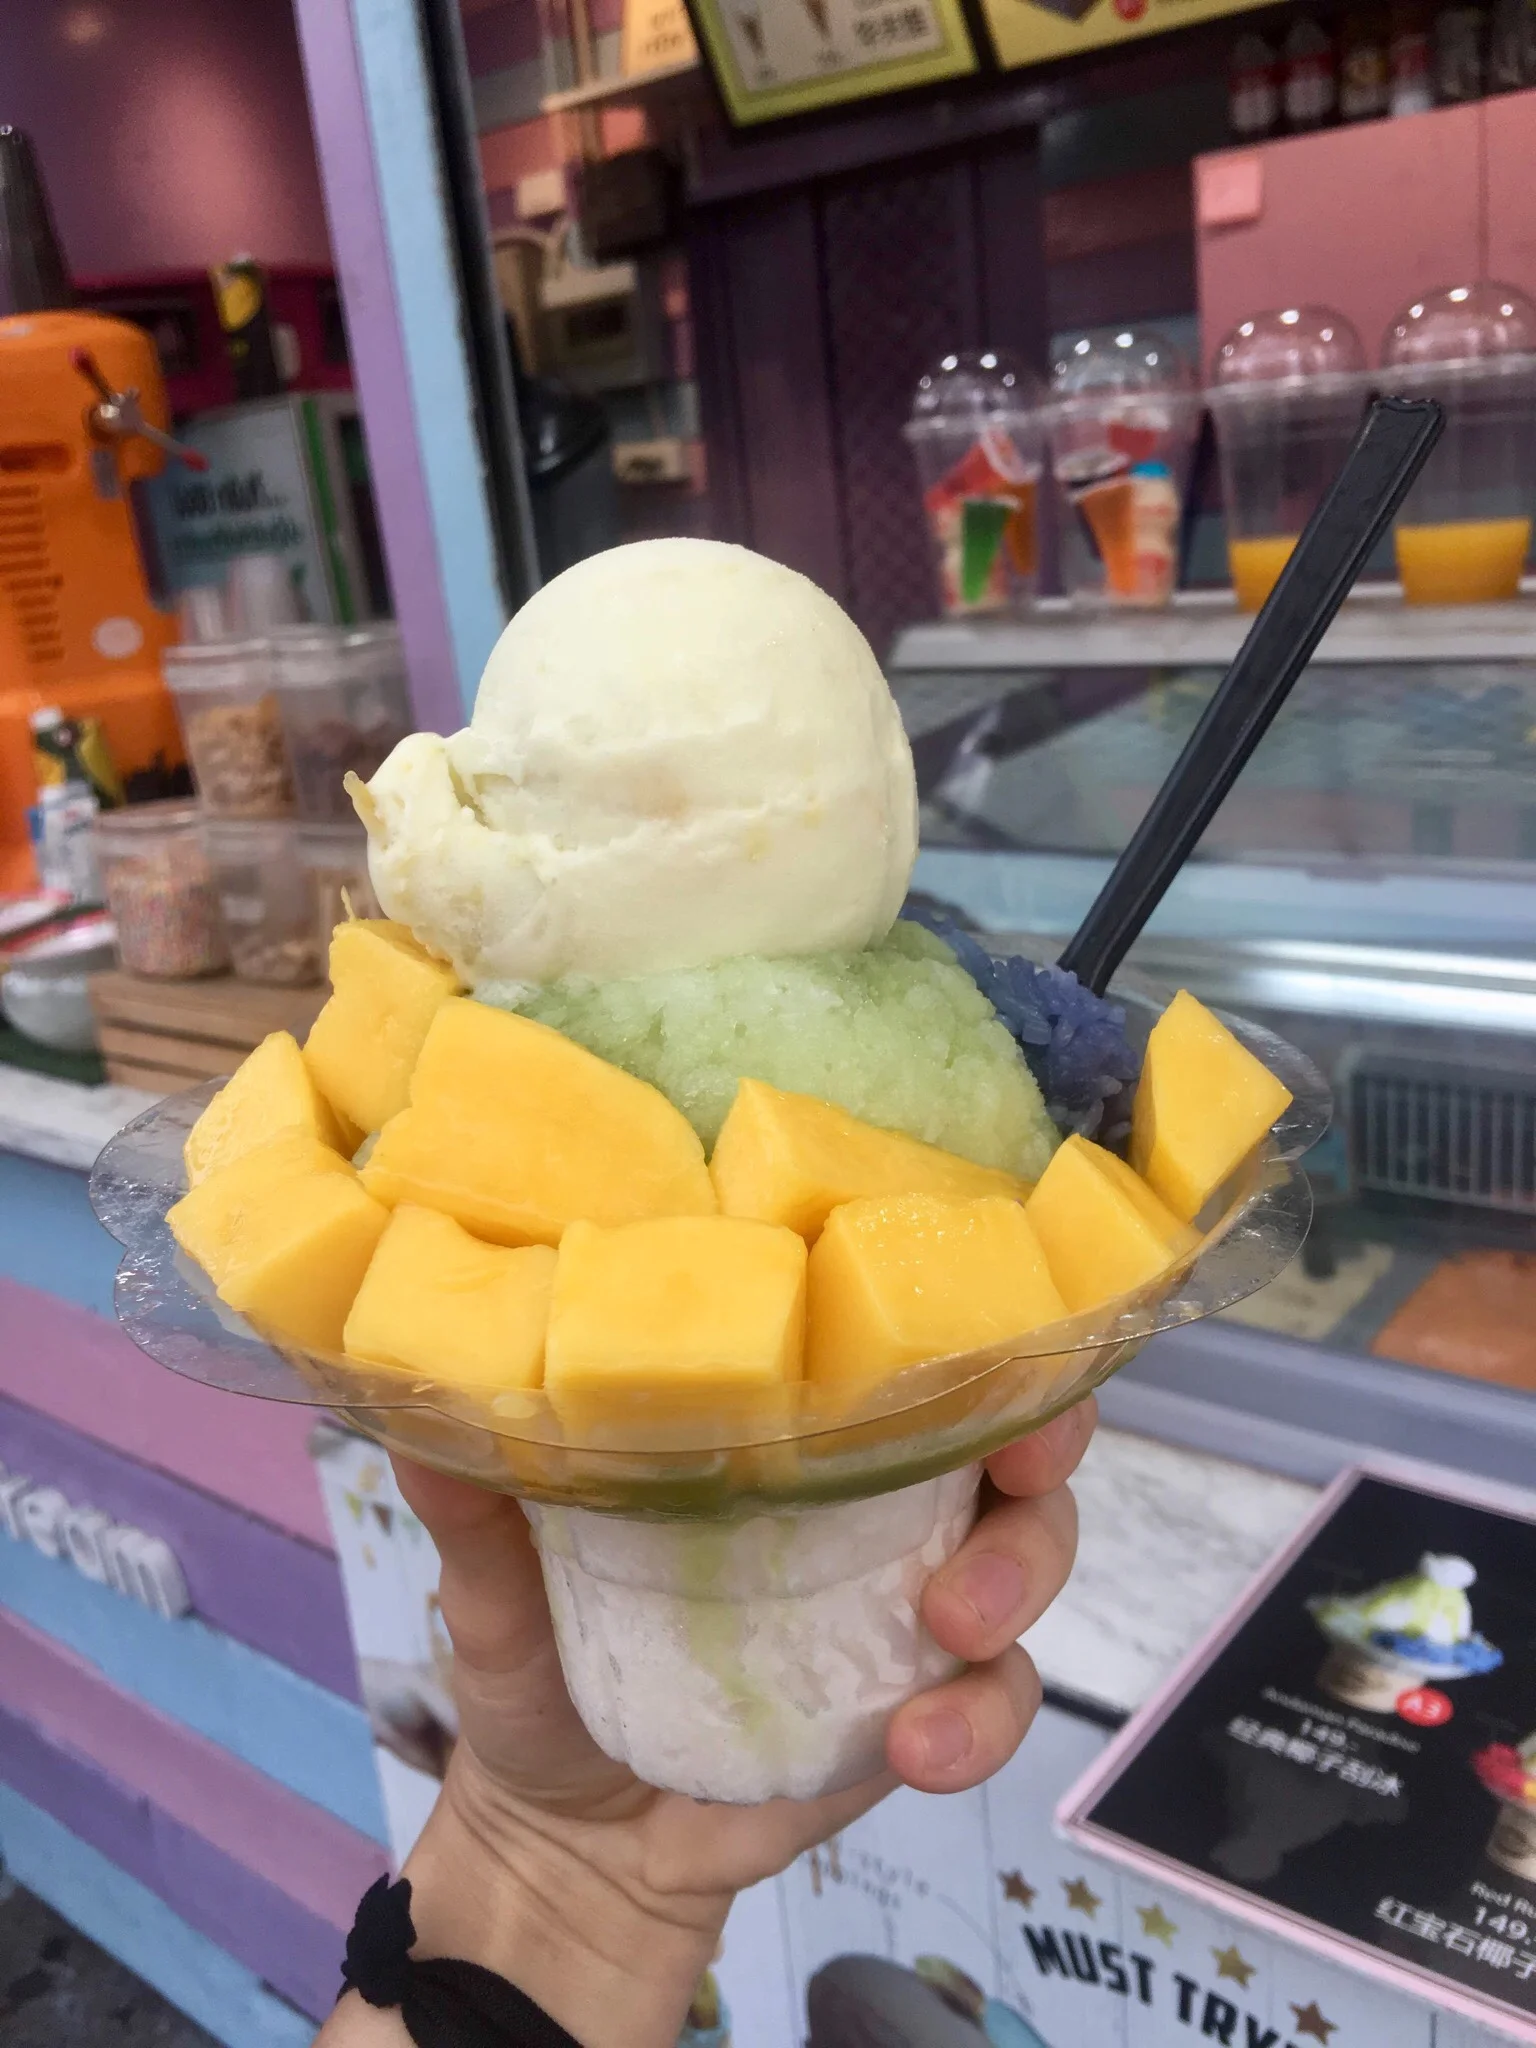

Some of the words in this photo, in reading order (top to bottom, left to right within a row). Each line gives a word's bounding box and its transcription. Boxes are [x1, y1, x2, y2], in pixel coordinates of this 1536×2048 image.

[0, 1463, 192, 1621] ream
[1022, 1923, 1155, 2007] MUST
[1172, 1971, 1300, 2048] TRY
